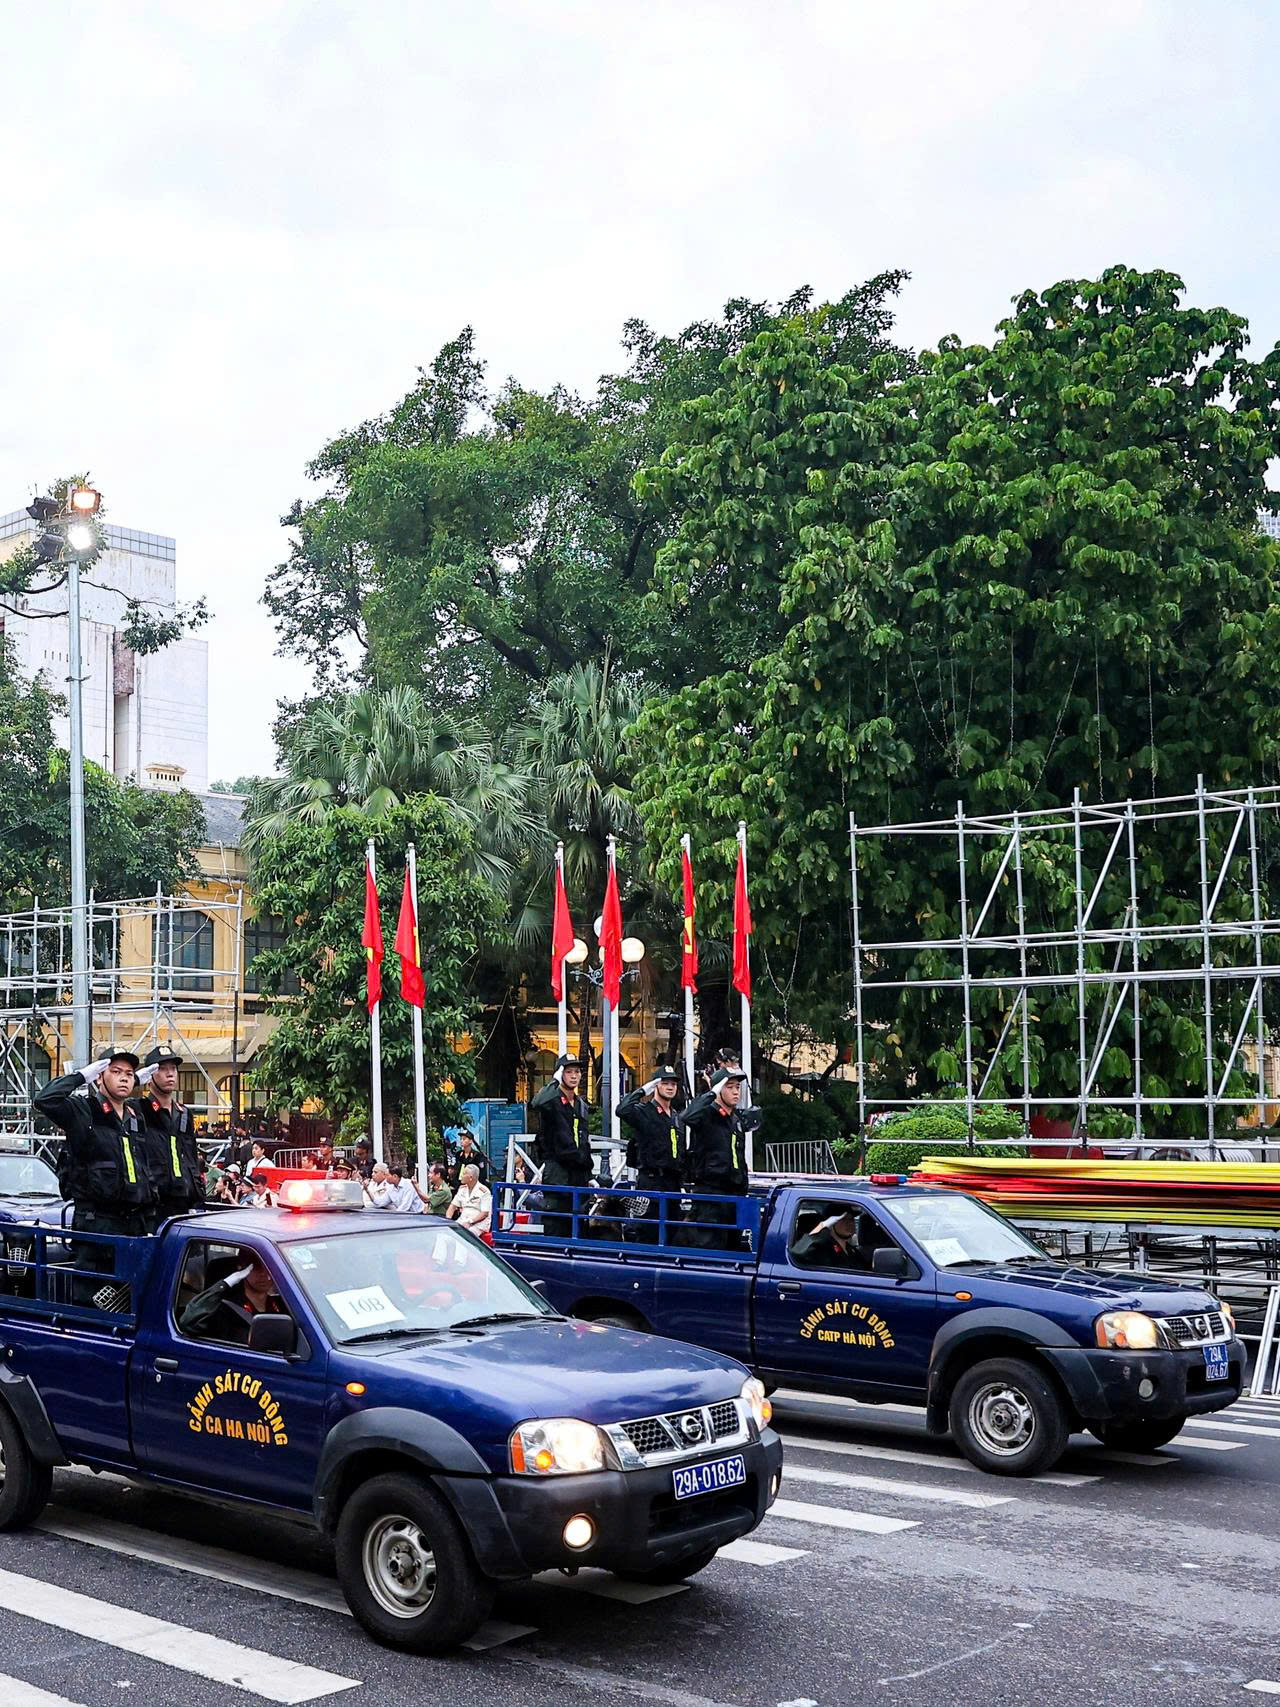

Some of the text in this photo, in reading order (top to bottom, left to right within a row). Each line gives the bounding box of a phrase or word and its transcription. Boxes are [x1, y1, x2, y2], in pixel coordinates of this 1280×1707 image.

[825, 1298, 849, 1316] SÁT
[851, 1303, 870, 1320] CƠ
[817, 1329, 841, 1342] CATP
[858, 1332, 876, 1348] NỘI
[1208, 1346, 1224, 1362] 29A
[214, 1368, 241, 1395] SÁT
[241, 1374, 263, 1399] CƠ
[258, 1390, 289, 1446] ĐỘNG
[205, 1415, 224, 1436] CA
[246, 1419, 271, 1448] NỘI
[676, 1458, 745, 1497] 29A-018.62
